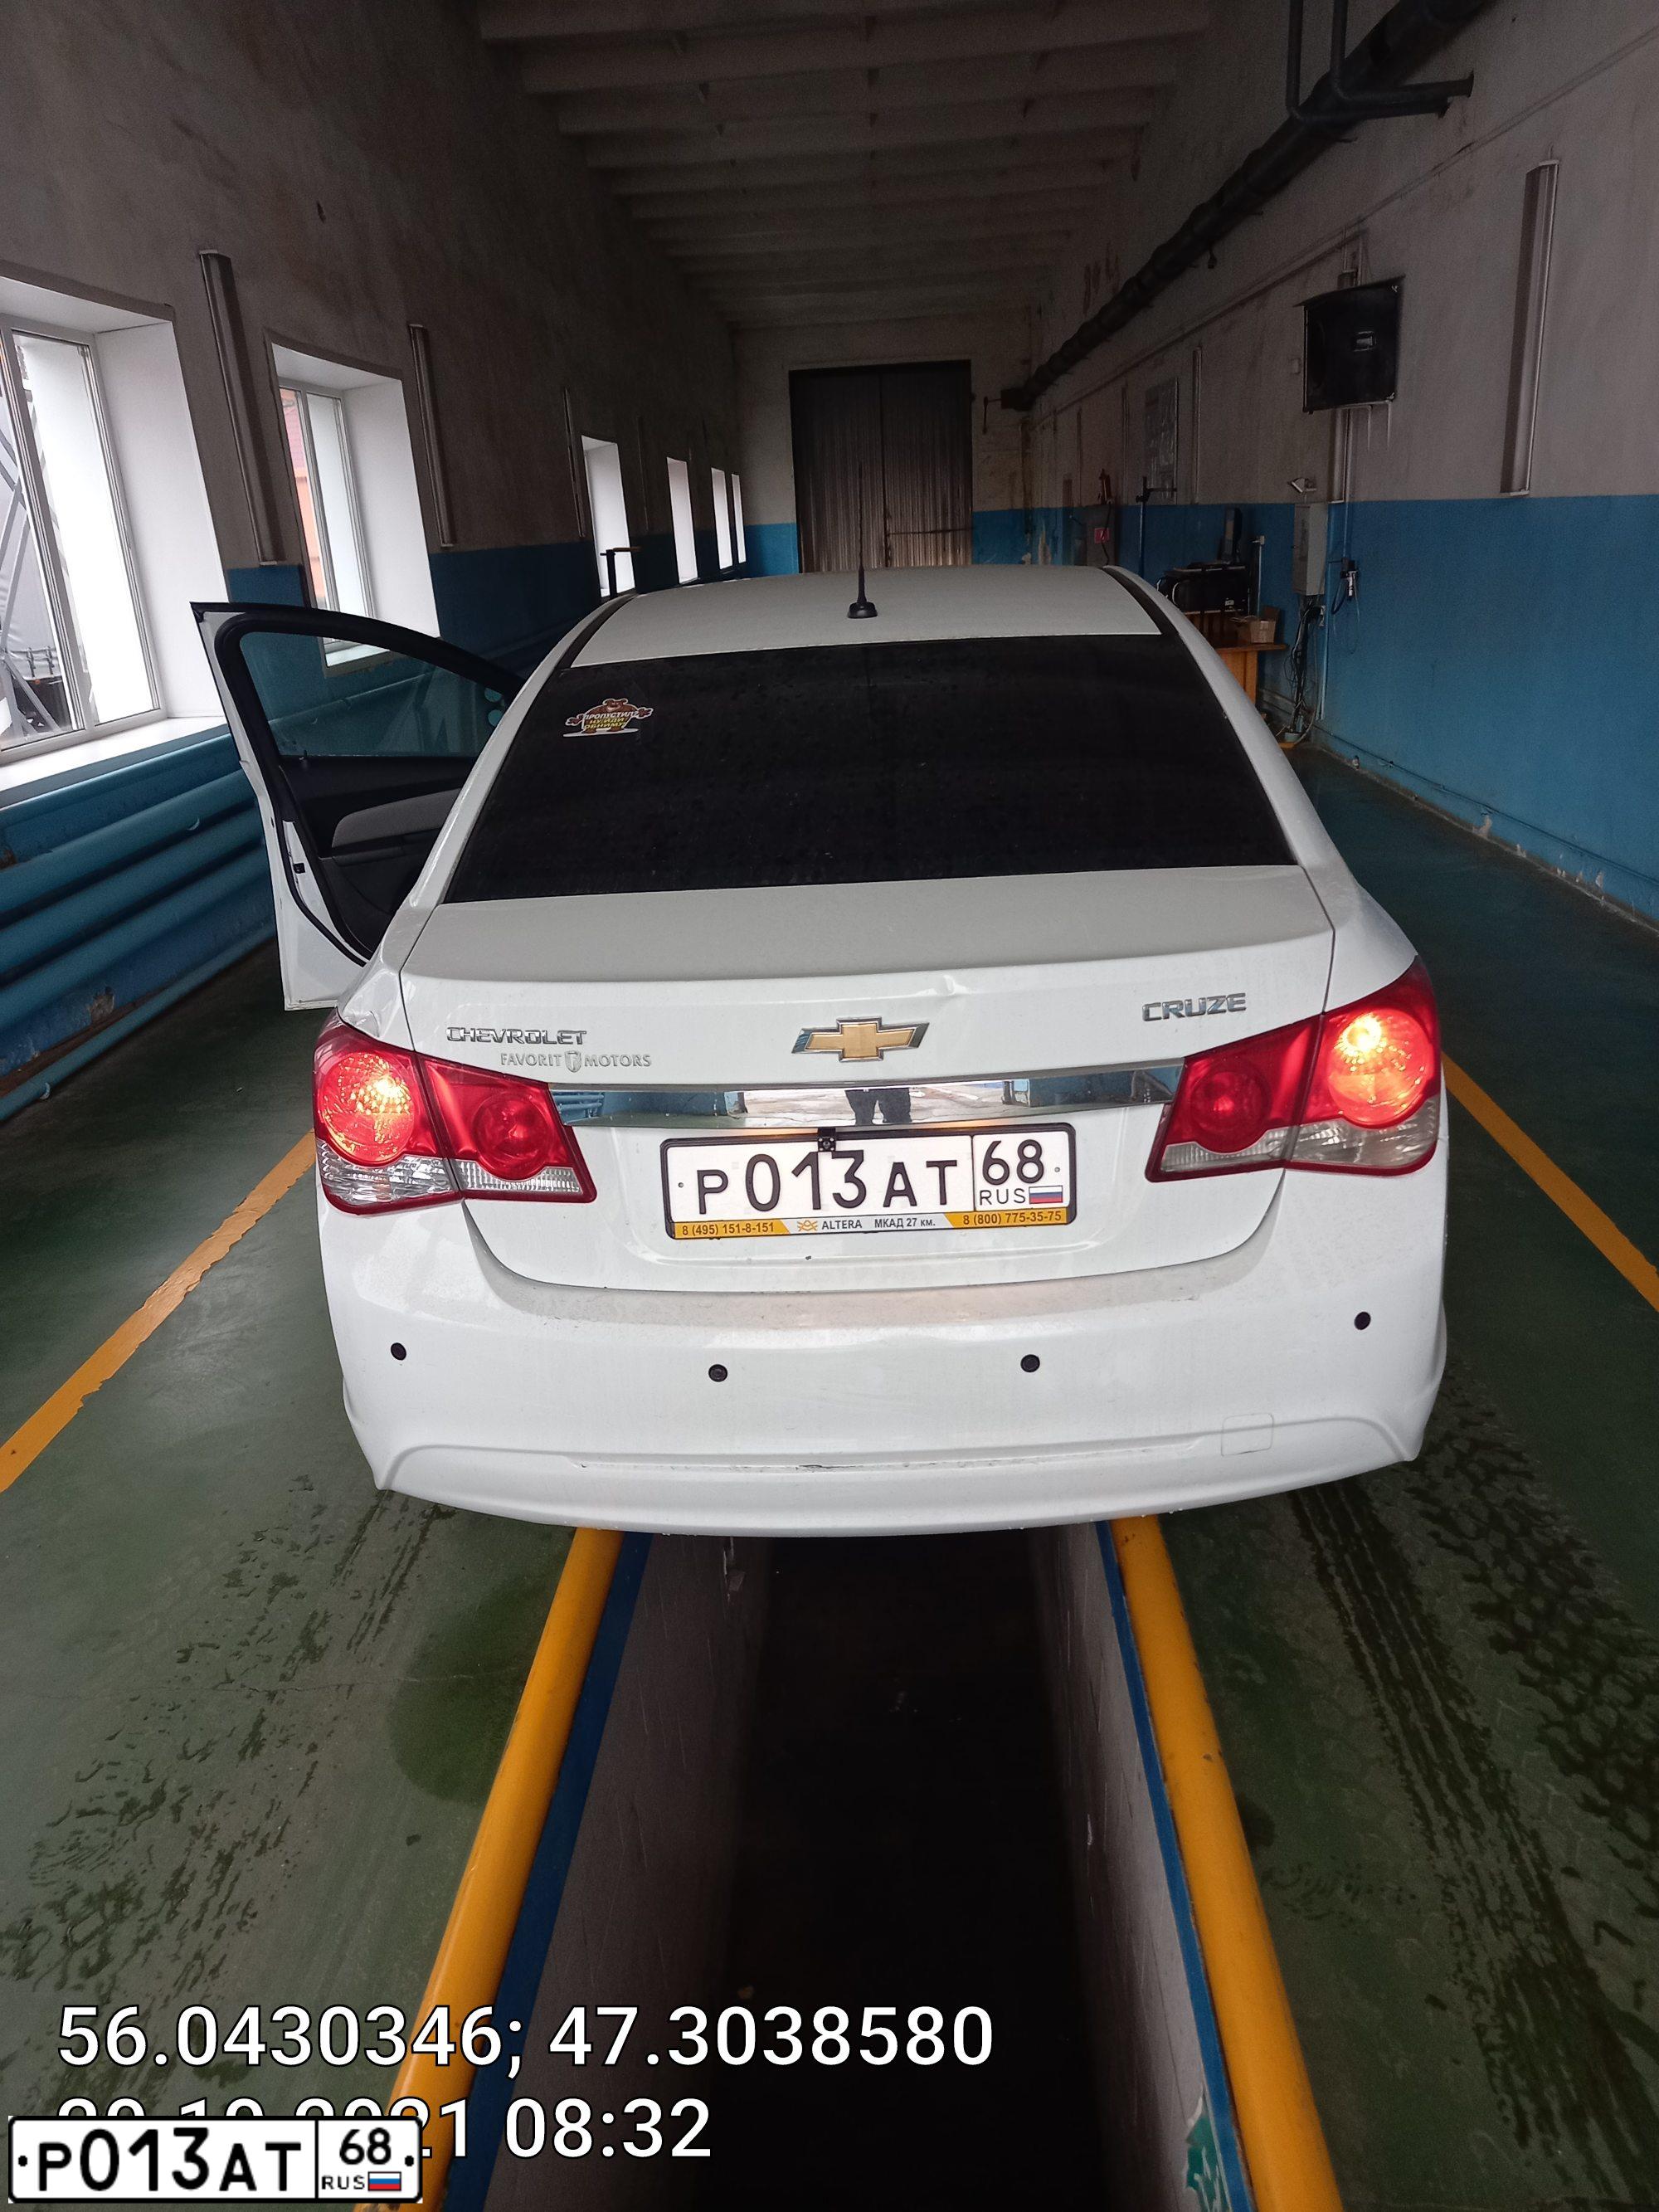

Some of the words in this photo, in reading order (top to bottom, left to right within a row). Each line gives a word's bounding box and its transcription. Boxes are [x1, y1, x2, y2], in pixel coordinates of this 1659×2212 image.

[1142, 992, 1247, 1022] CRUZE
[445, 1026, 587, 1045] CHEVROLET
[500, 1052, 562, 1067] FAVORIT
[584, 1053, 652, 1068] MOTORS
[981, 1138, 1045, 1185] 68
[979, 1187, 1027, 1206] RUS
[682, 1225, 689, 1235] 8
[692, 1224, 719, 1237] (495)
[722, 1222, 775, 1235] 151-8-151
[821, 1219, 863, 1230] ALTERA
[874, 1217, 904, 1230] МКАД
[907, 1216, 917, 1228] 27
[963, 1214, 971, 1225] 8
[973, 1212, 1002, 1226] (800)
[1005, 1211, 1063, 1223] 775-35-75
